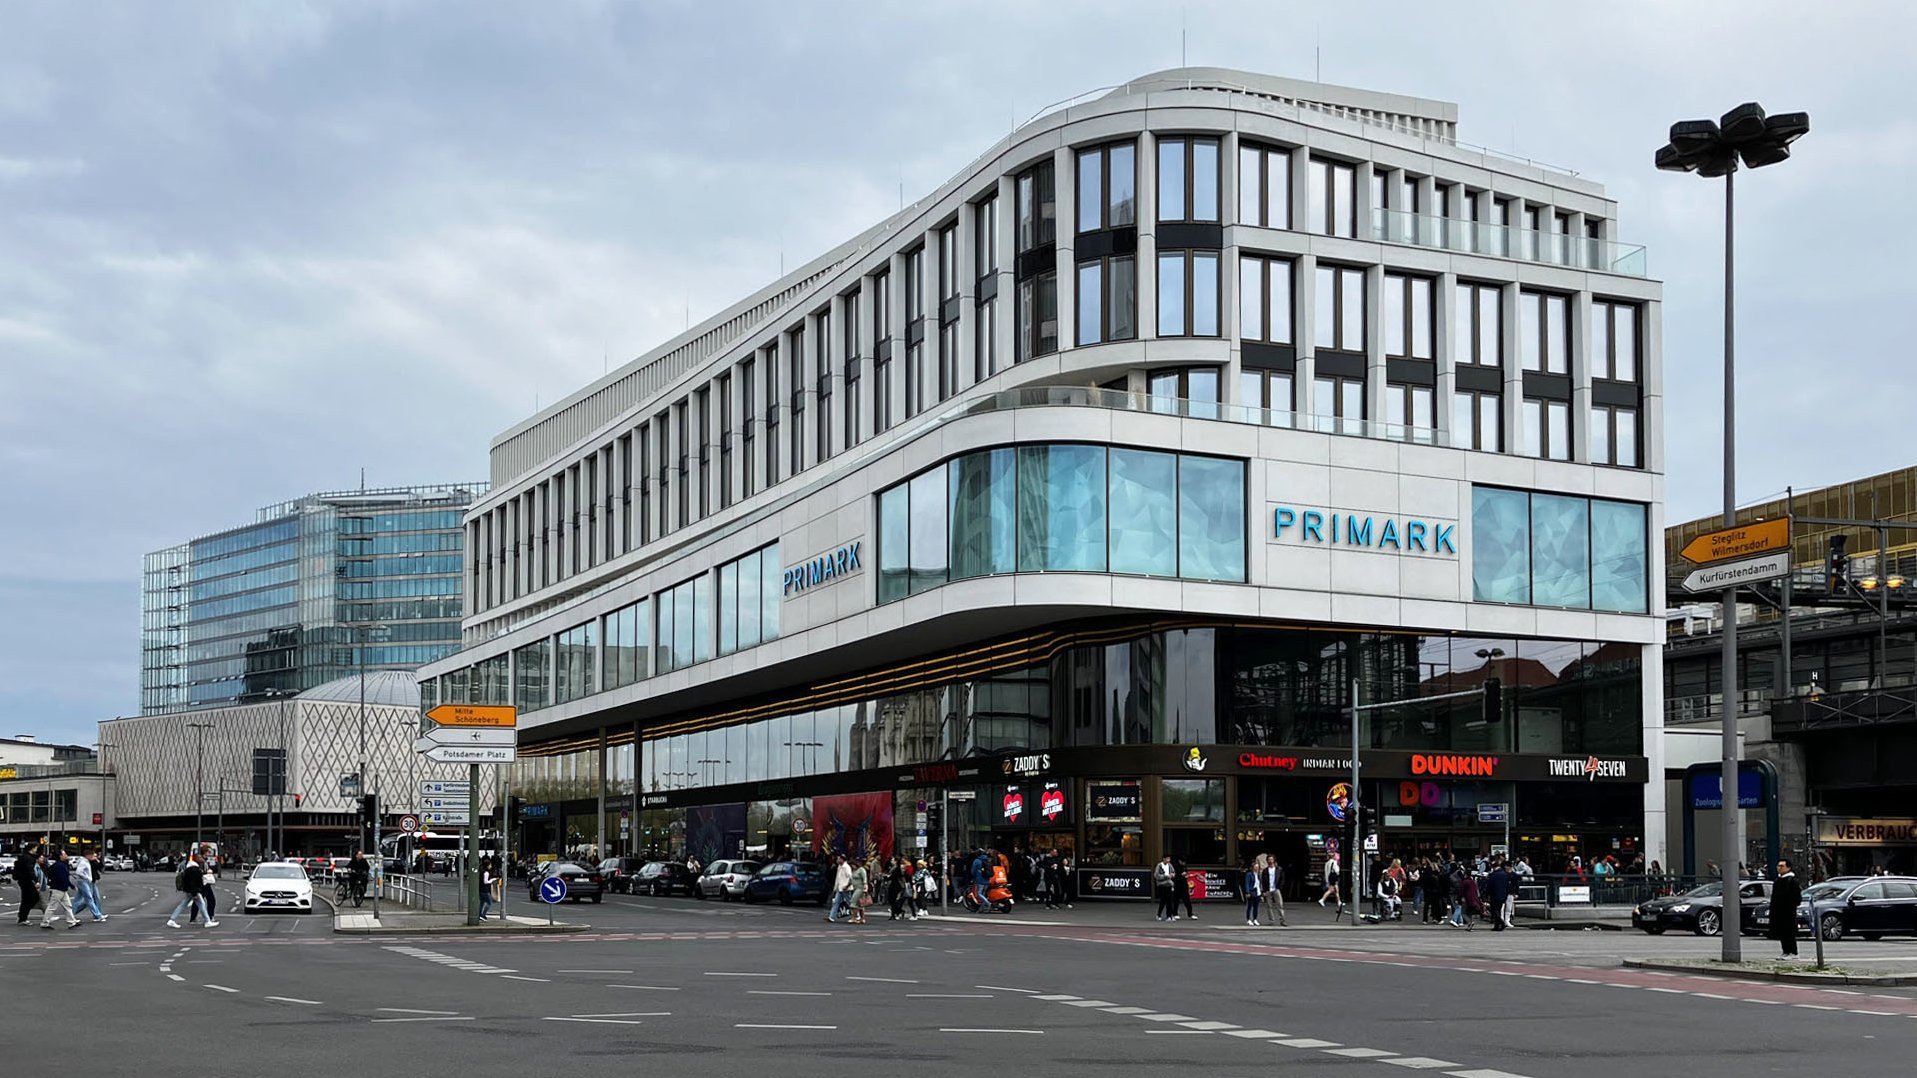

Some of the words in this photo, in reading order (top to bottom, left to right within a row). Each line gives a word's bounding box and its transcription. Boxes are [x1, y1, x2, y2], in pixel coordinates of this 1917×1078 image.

[1274, 507, 1456, 554] PRIMARK
[1711, 531, 1746, 545] Steglitz
[1711, 537, 1769, 557] Wilmersdorf
[783, 541, 861, 596] PRIMARK
[1700, 563, 1778, 583] Kurfürstendamm
[455, 715, 499, 724] Schöneberg
[443, 750, 484, 758] Potsdamer
[487, 750, 506, 758] Platz
[1239, 753, 1298, 771] Chutney
[1303, 759, 1335, 768] INDIAN
[1411, 754, 1499, 776] DUNKIN'
[404, 820, 414, 828] 30
